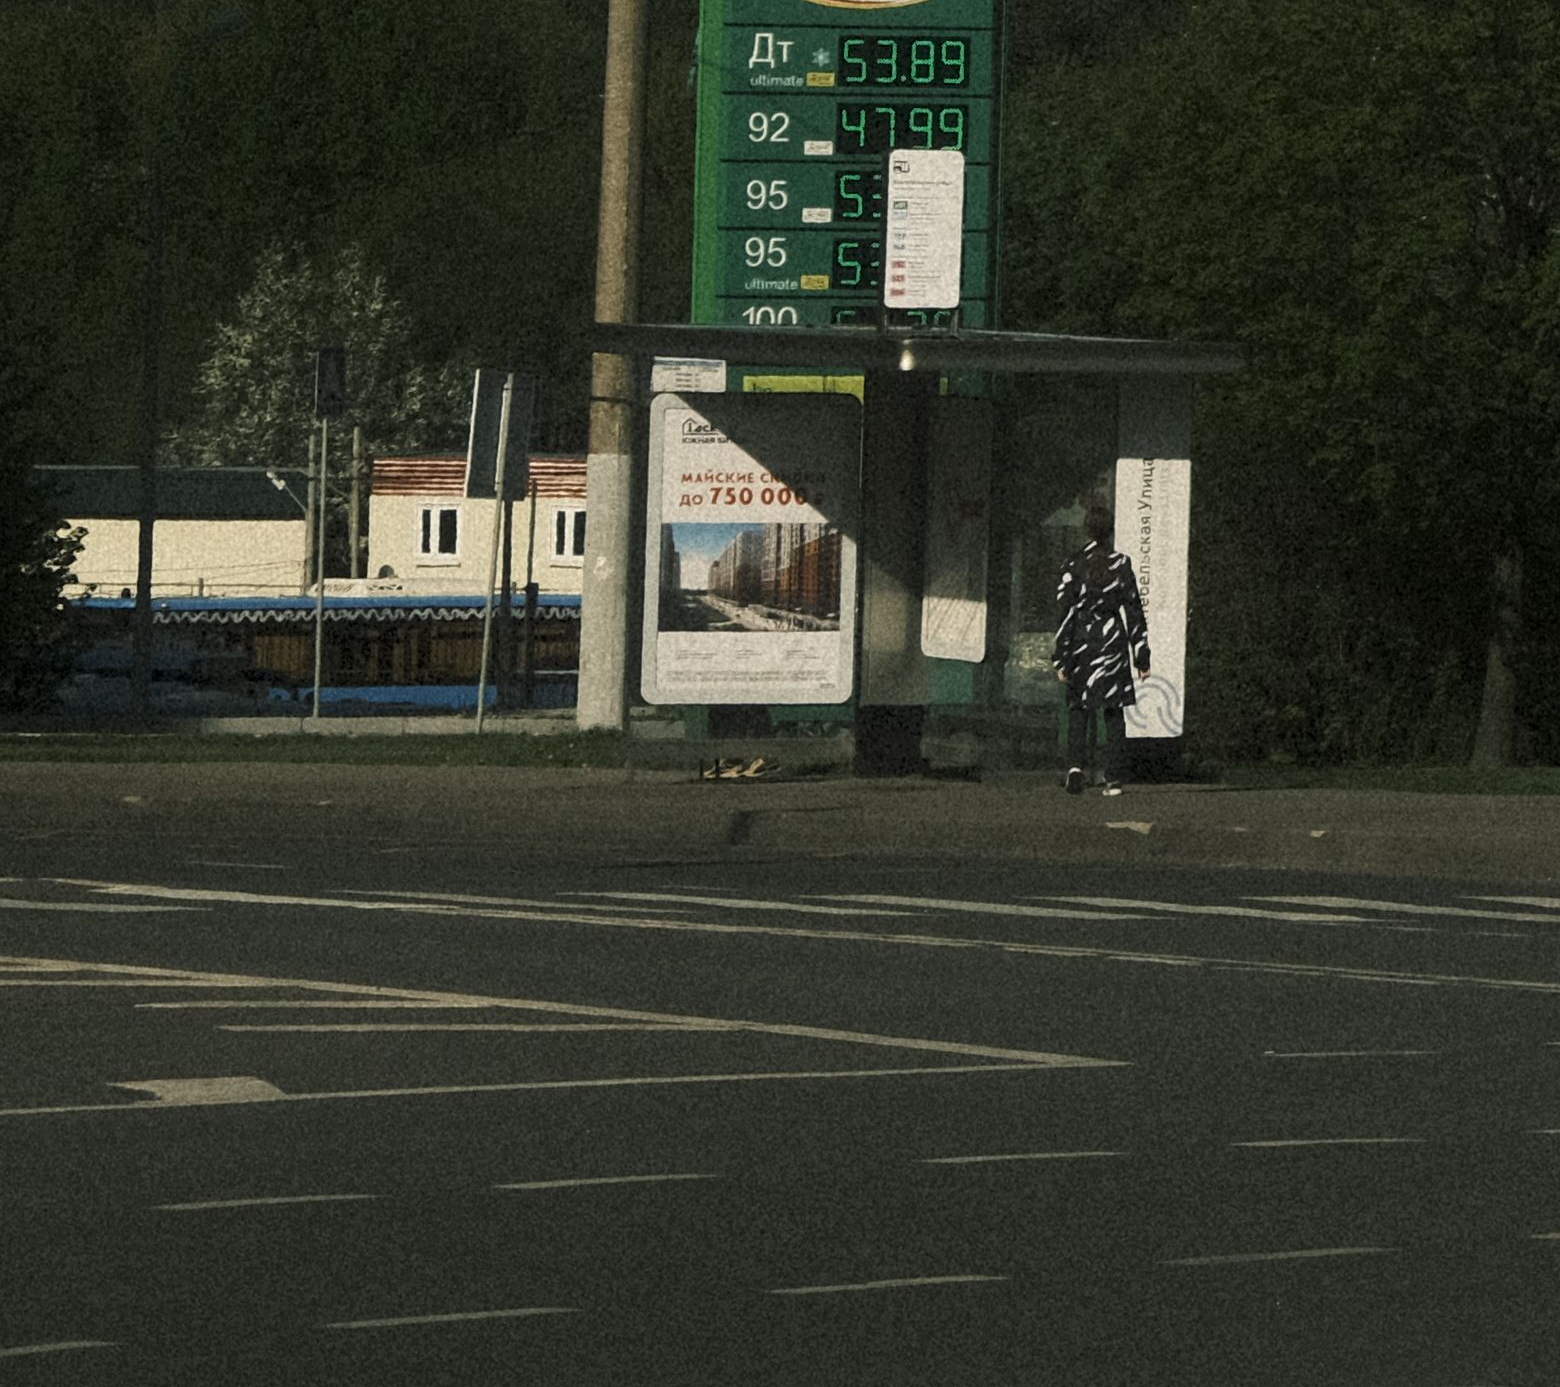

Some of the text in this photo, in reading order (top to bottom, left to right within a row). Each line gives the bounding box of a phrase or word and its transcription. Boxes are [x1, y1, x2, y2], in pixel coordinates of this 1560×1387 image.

[843, 39, 966, 85] 53.89
[750, 74, 804, 87] ultimate
[748, 112, 791, 143] 92
[746, 179, 789, 211] 95
[744, 236, 787, 268] 95
[744, 277, 799, 290] ultimate
[682, 469, 754, 484] МАЙСКИЕ
[1138, 458, 1156, 511] Улица
[709, 487, 753, 506] 750
[760, 487, 808, 506] 000
